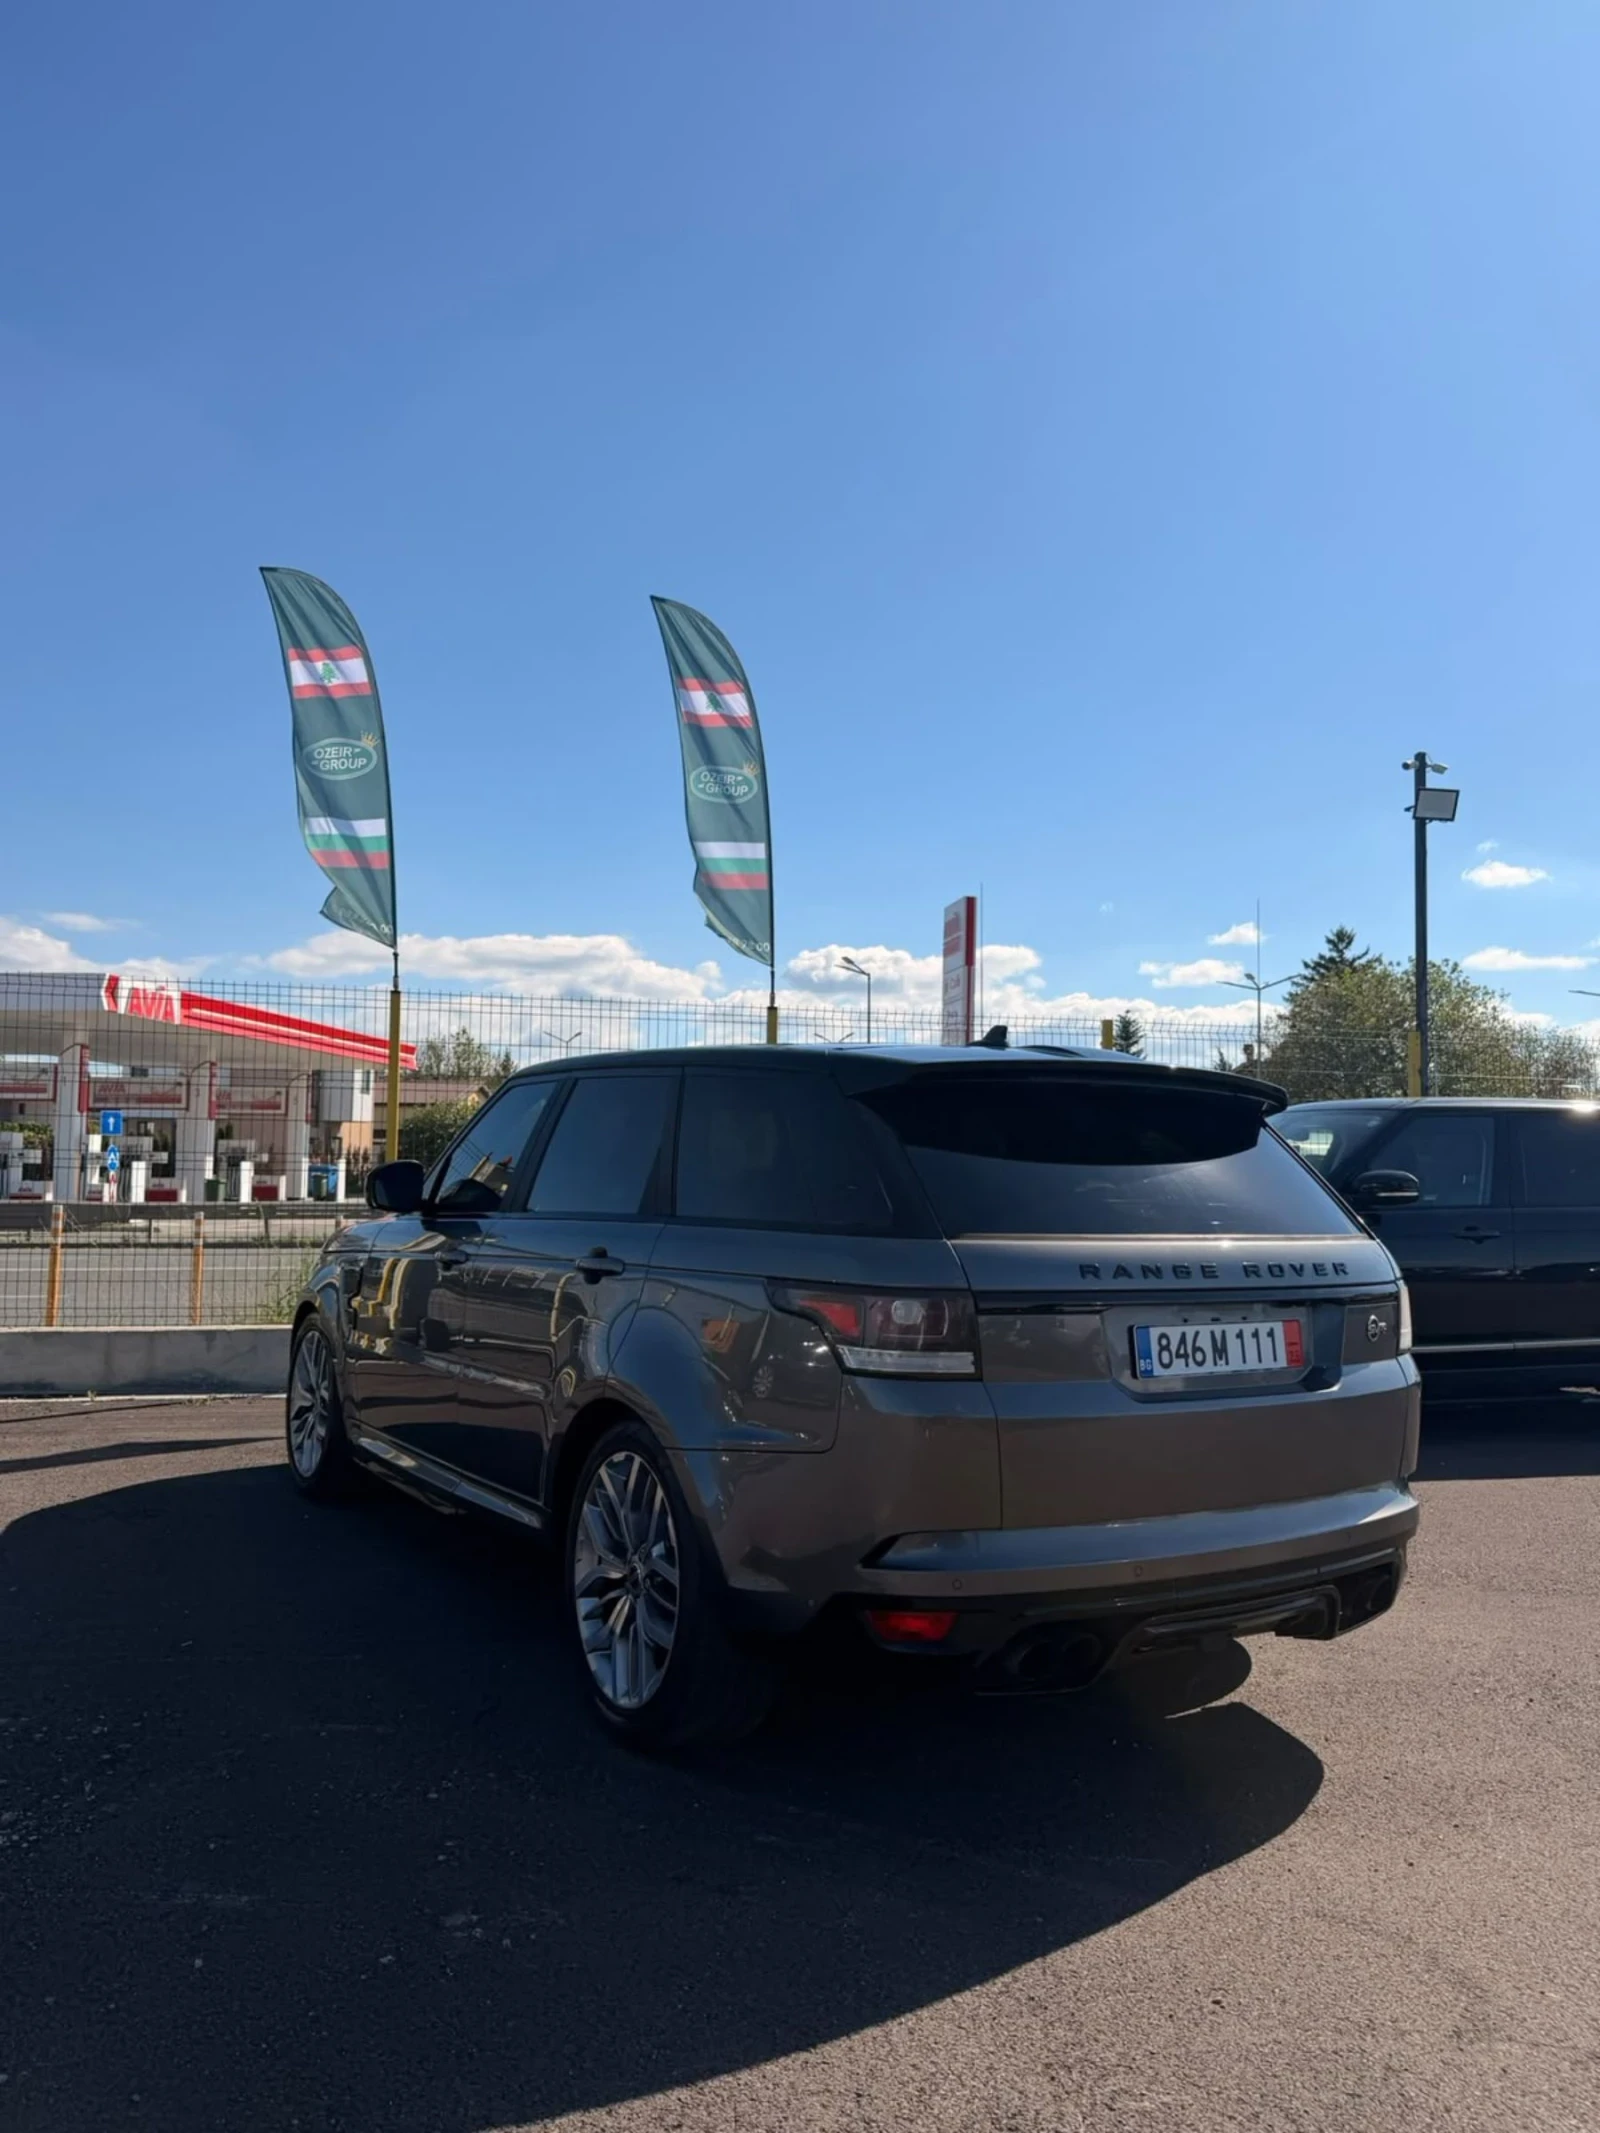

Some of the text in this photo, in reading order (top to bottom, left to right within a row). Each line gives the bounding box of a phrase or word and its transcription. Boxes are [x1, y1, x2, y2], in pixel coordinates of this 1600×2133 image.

[313, 746, 353, 759] OZEIR
[319, 758, 367, 770] GROUP
[705, 783, 749, 796] GROUP
[128, 986, 175, 1022] AVIA
[1079, 1261, 1350, 1280] RANGE ROVER
[1139, 1359, 1152, 1371] BG
